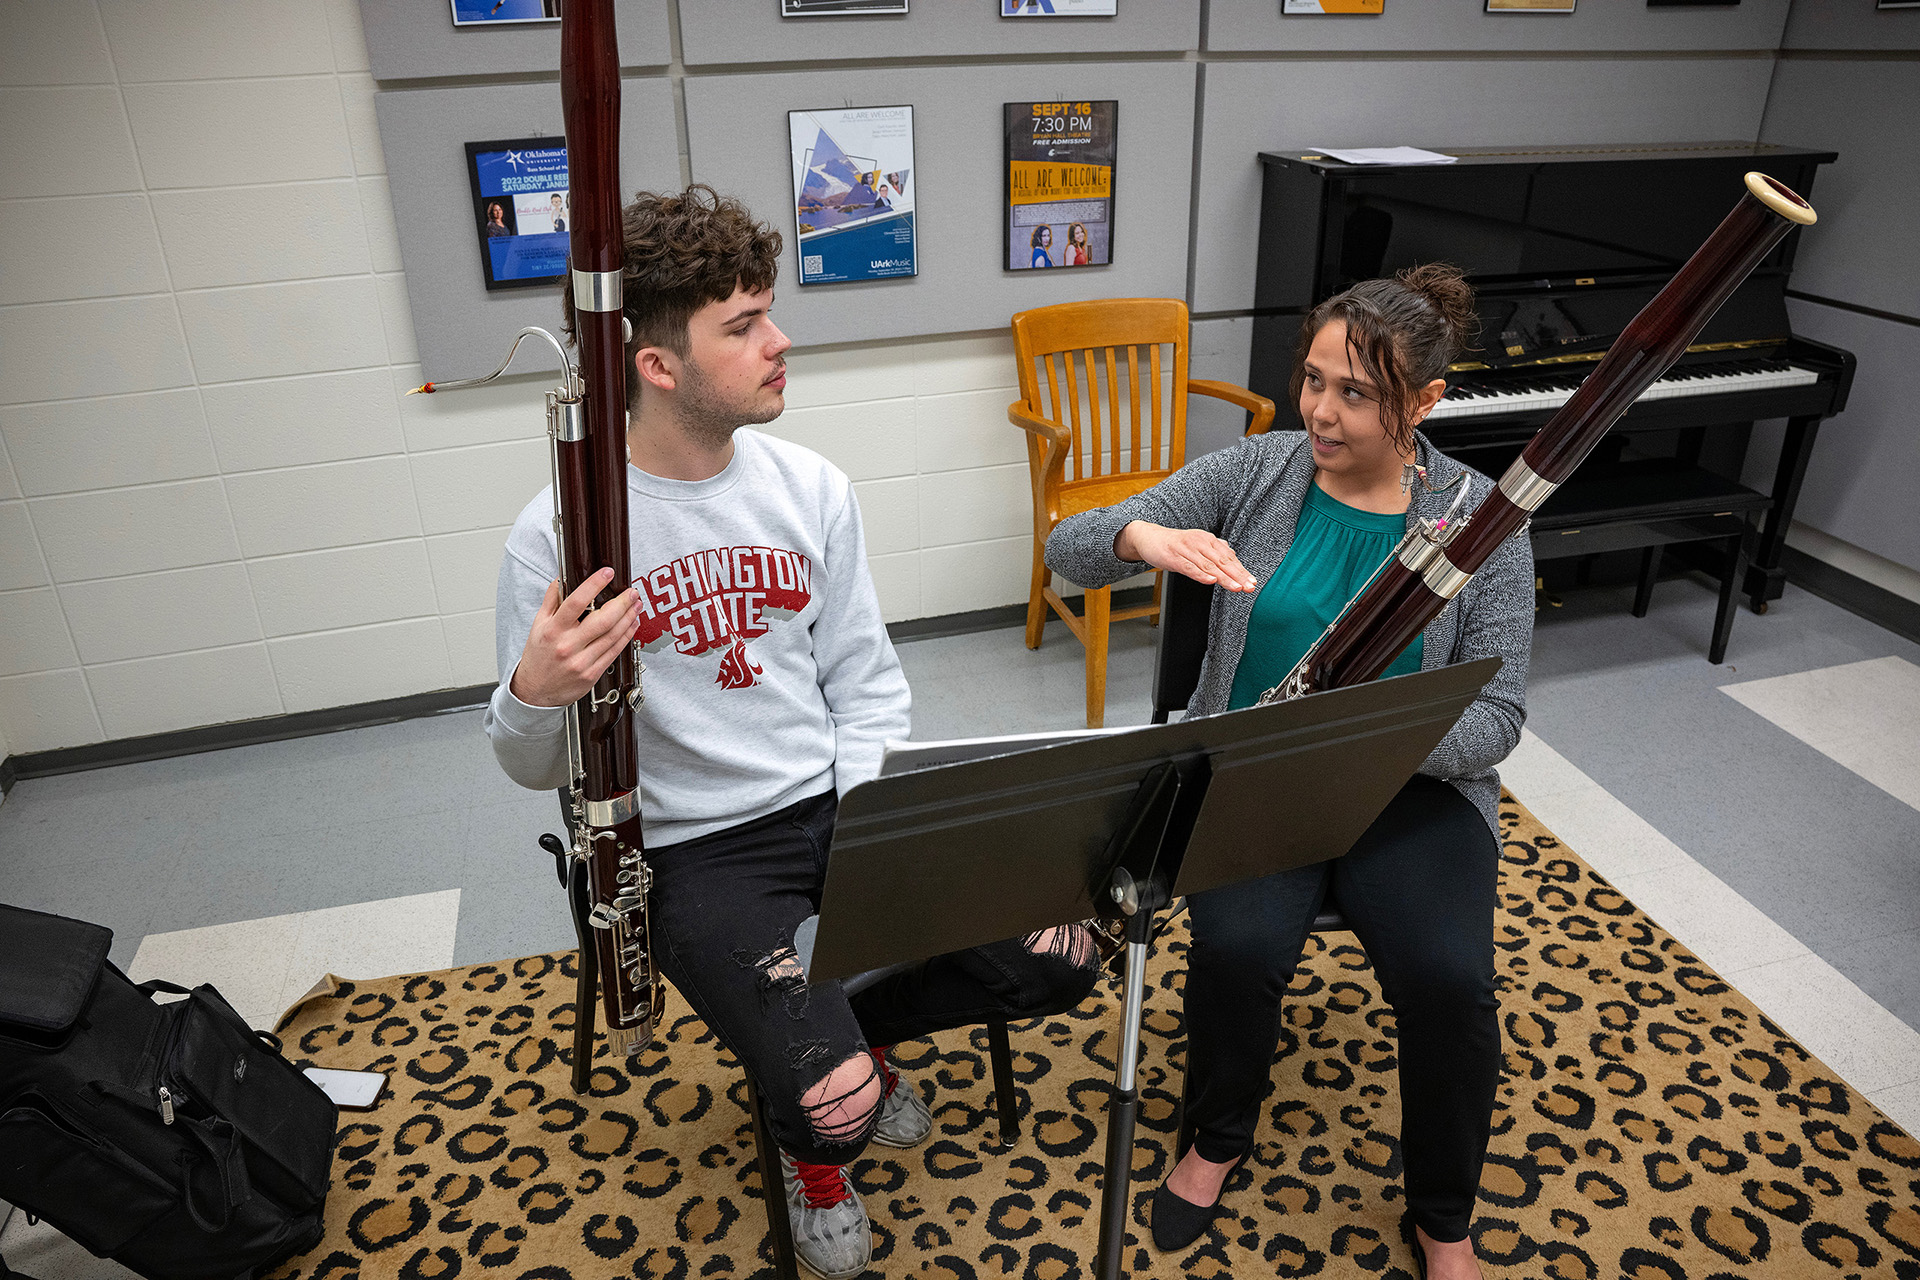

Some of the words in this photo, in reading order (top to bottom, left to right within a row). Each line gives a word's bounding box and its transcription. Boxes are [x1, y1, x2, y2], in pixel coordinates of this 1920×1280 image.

[1032, 103, 1071, 116] SEPT
[1074, 102, 1091, 115] 16
[1032, 117, 1065, 133] 7:30
[1069, 116, 1092, 131] PM
[501, 177, 522, 186] 2022
[523, 174, 552, 184] DOUBLE
[1013, 169, 1029, 189] ALL
[1036, 168, 1053, 188] ARE
[1061, 166, 1106, 187] WELCOME:
[502, 182, 545, 192] SATURDAY,
[870, 257, 912, 268] UArkMusic
[631, 545, 812, 623] ASHINGTON
[668, 591, 769, 653] STATE
